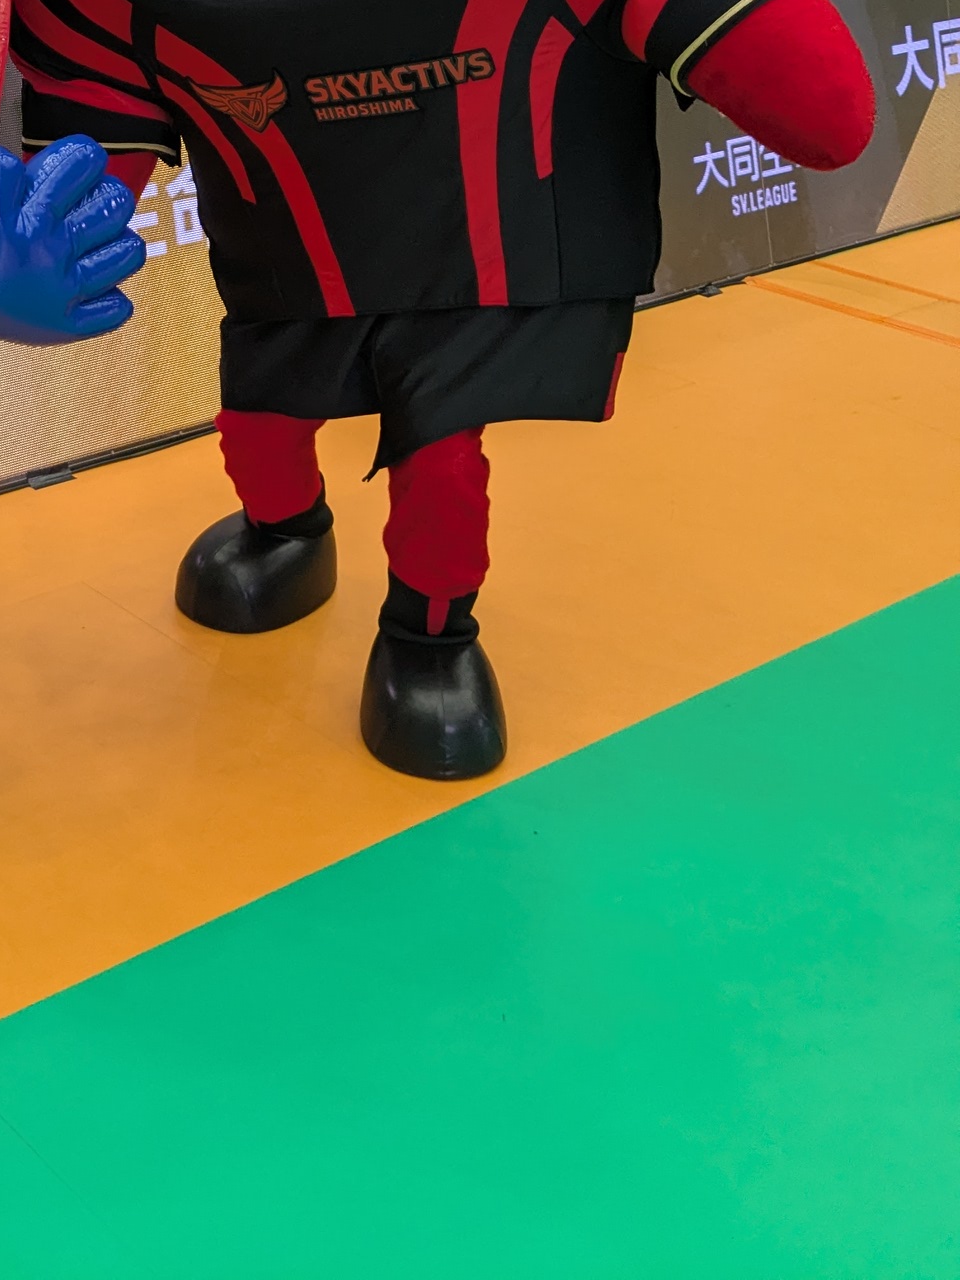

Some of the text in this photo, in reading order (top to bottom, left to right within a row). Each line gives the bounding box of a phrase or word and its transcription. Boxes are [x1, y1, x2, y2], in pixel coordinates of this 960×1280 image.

[305, 49, 495, 104] SKYACTIVS
[314, 97, 417, 121] HIROSHIMA
[693, 135, 800, 195] 大同生
[731, 181, 798, 216] SV.LEAGUE
